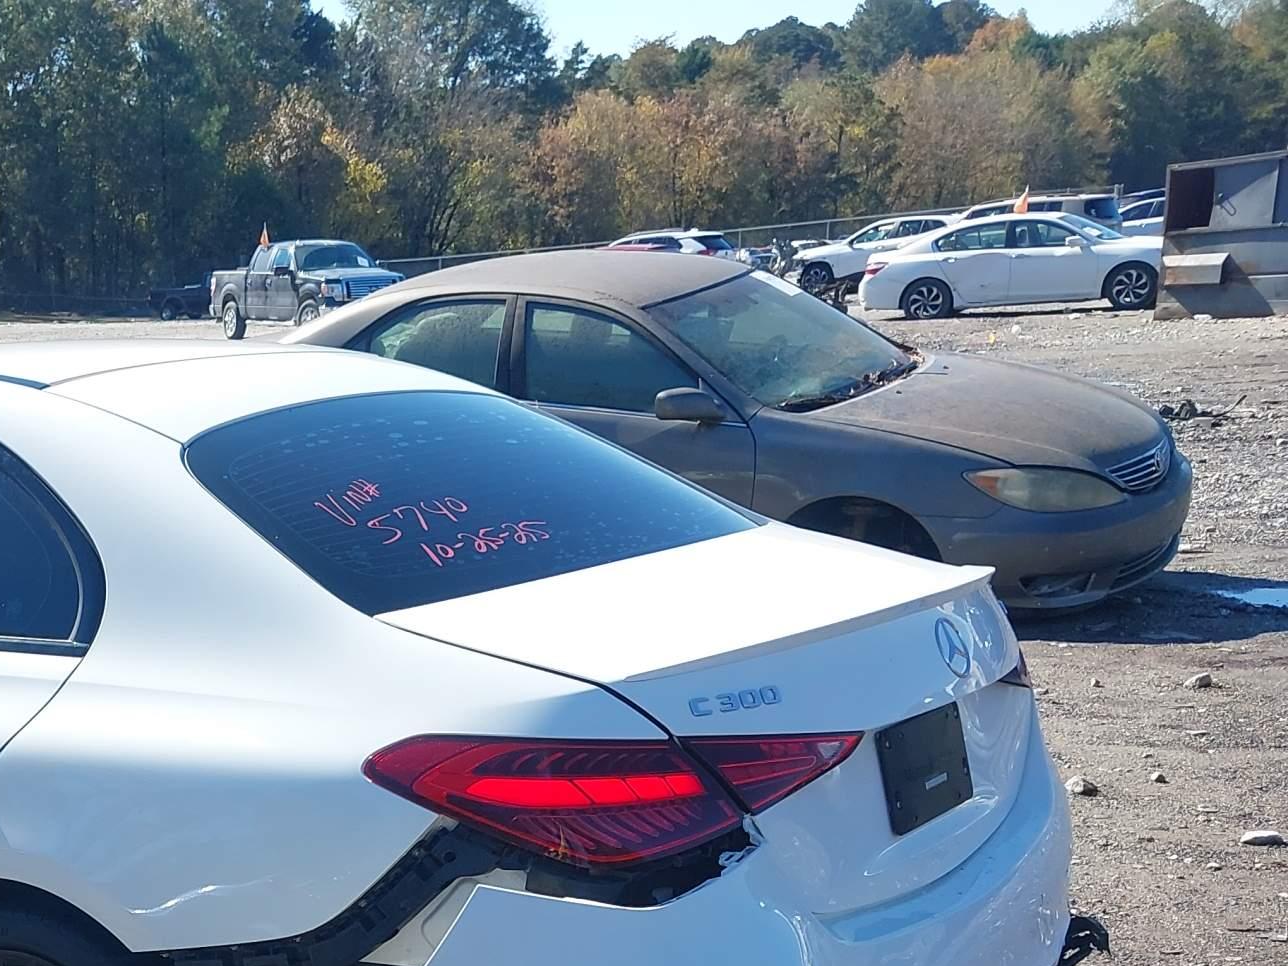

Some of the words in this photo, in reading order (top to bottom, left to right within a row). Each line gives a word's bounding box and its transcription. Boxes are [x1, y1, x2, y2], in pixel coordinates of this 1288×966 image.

[367, 497, 468, 545] 5740
[688, 697, 713, 717] C
[715, 685, 782, 713] 300
